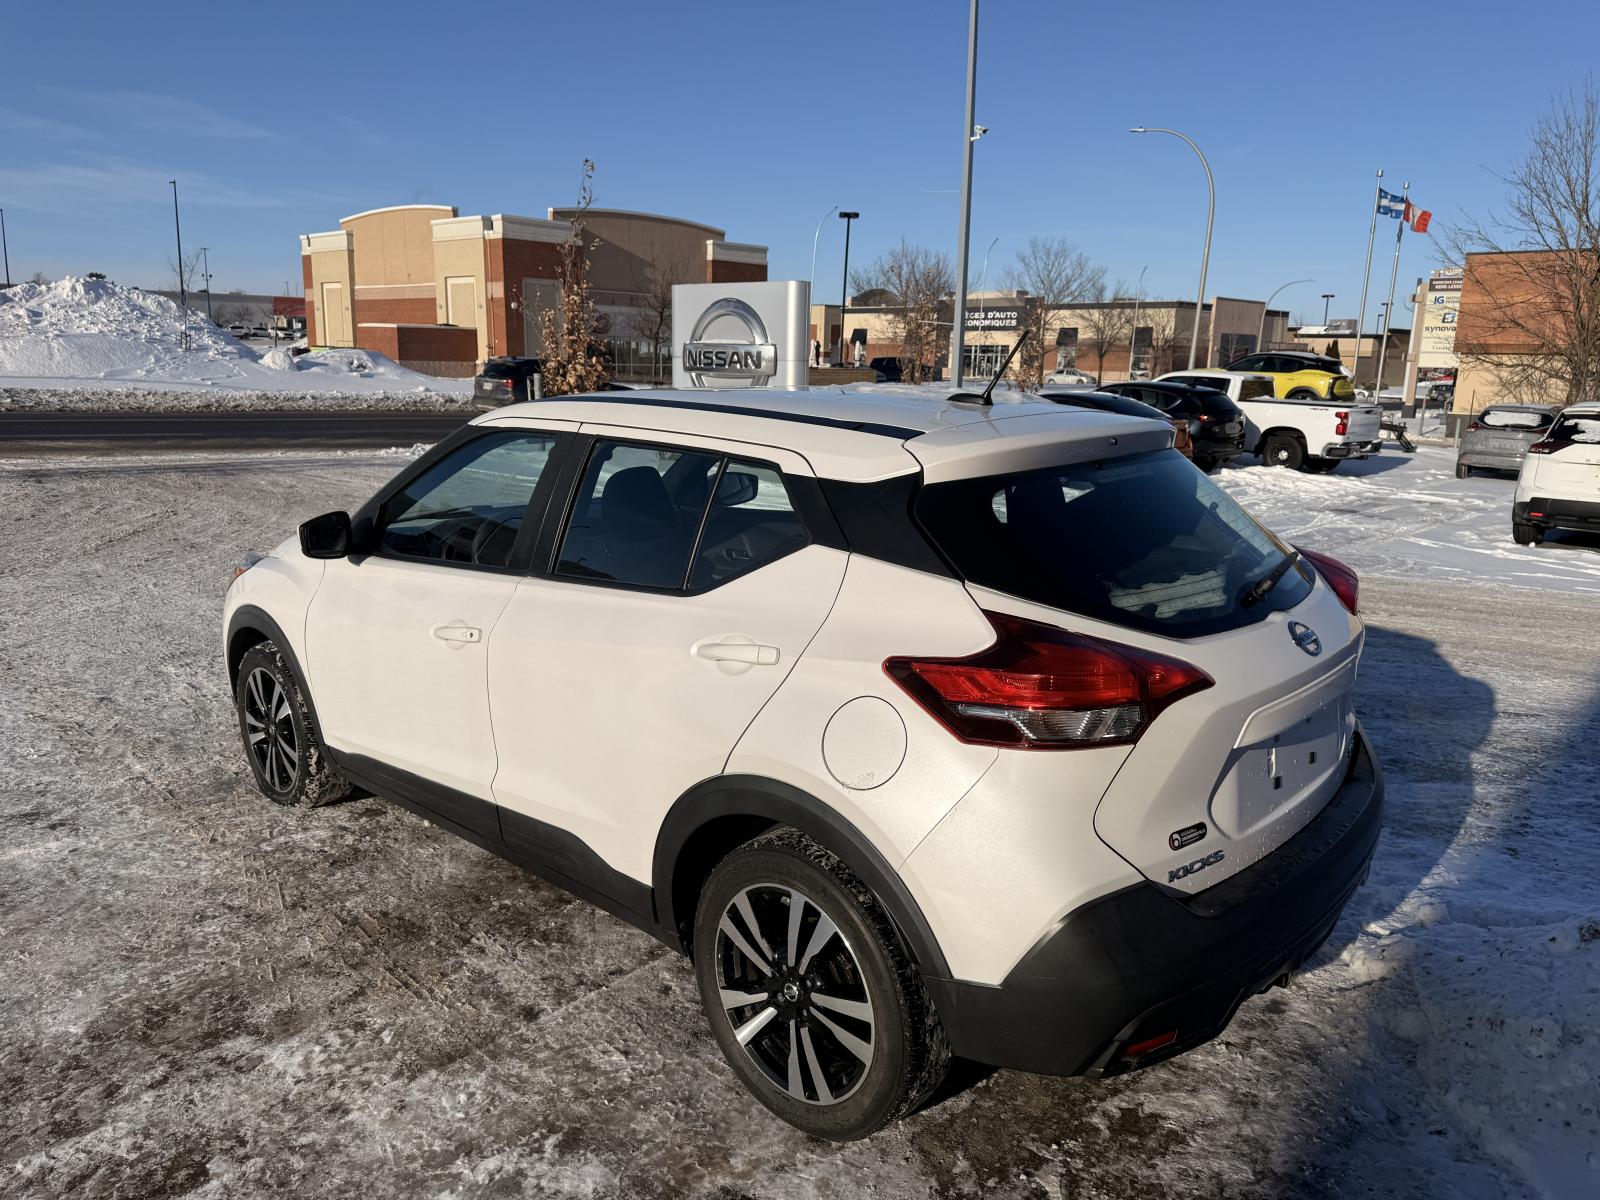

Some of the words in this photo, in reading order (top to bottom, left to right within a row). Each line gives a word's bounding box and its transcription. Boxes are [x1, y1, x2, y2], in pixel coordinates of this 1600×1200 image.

[1433, 295, 1445, 304] IG
[987, 310, 1018, 319] D'AUTO
[687, 349, 762, 369] NISSAN
[1168, 849, 1225, 883] KICKS
